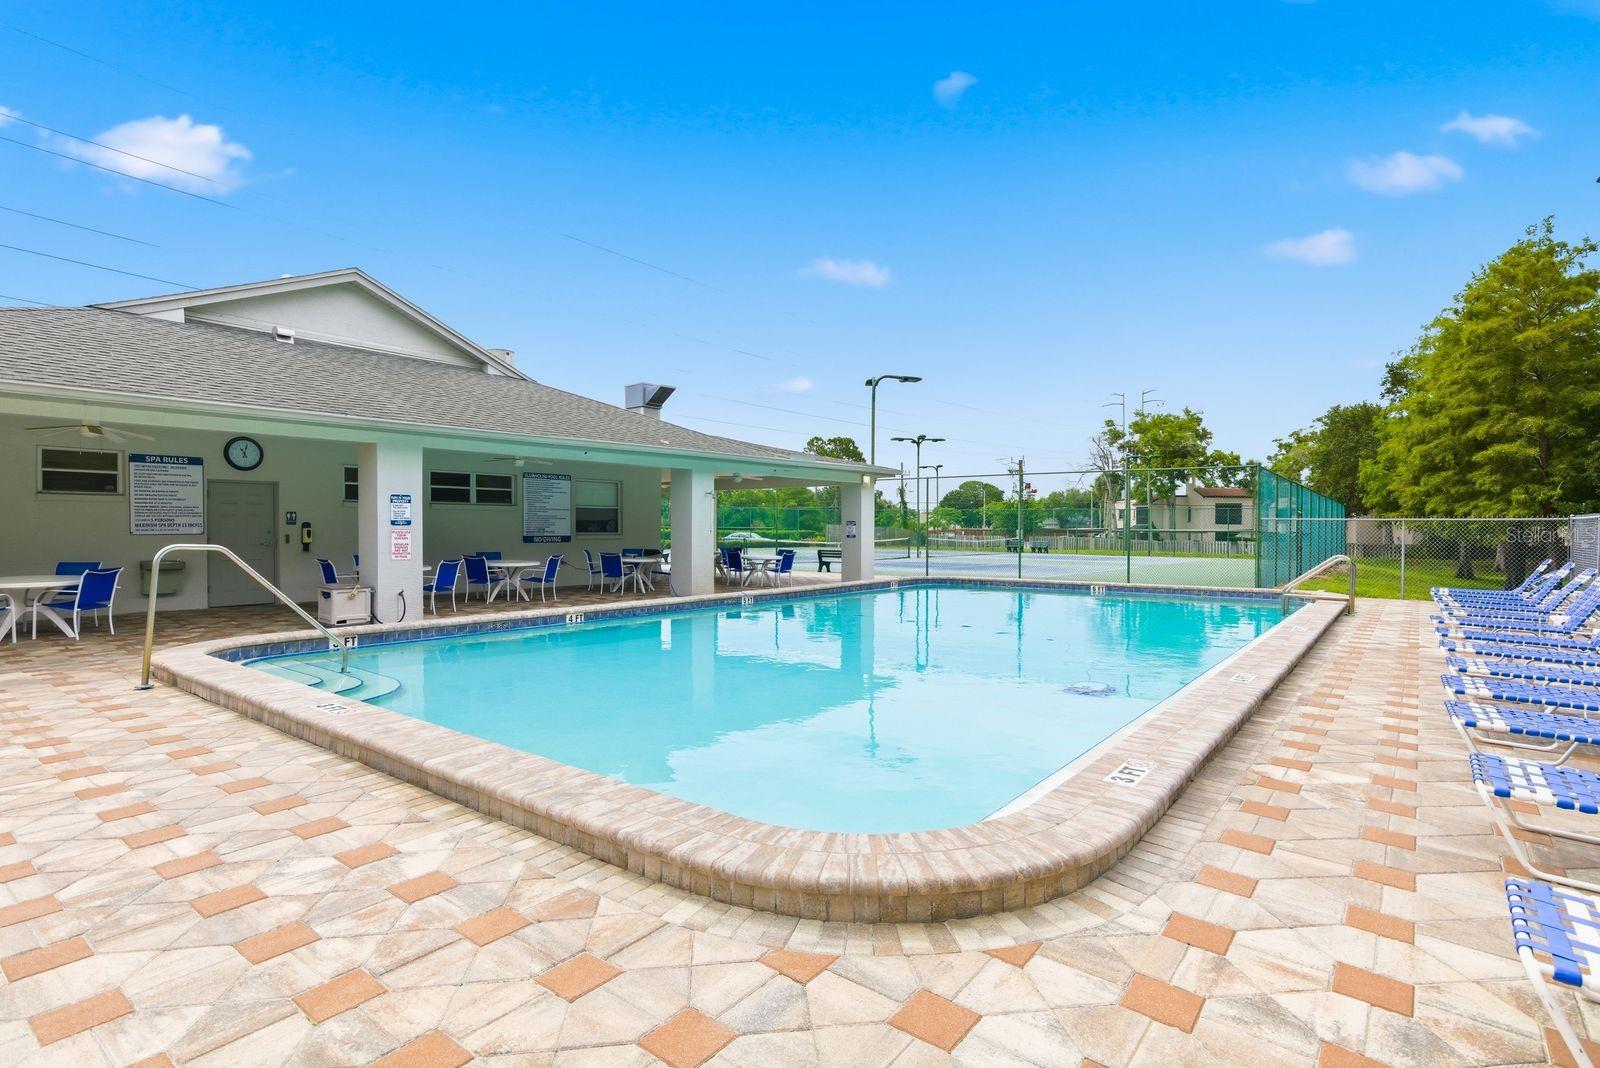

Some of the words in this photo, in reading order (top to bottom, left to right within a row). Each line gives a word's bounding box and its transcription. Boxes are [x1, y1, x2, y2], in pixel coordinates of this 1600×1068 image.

[145, 455, 161, 463] SPA
[162, 456, 189, 464] RULES
[568, 614, 573, 622] 4
[575, 614, 583, 622] FT
[344, 636, 357, 646] FT
[1118, 765, 1146, 778] FT
[1110, 776, 1136, 784] 3
